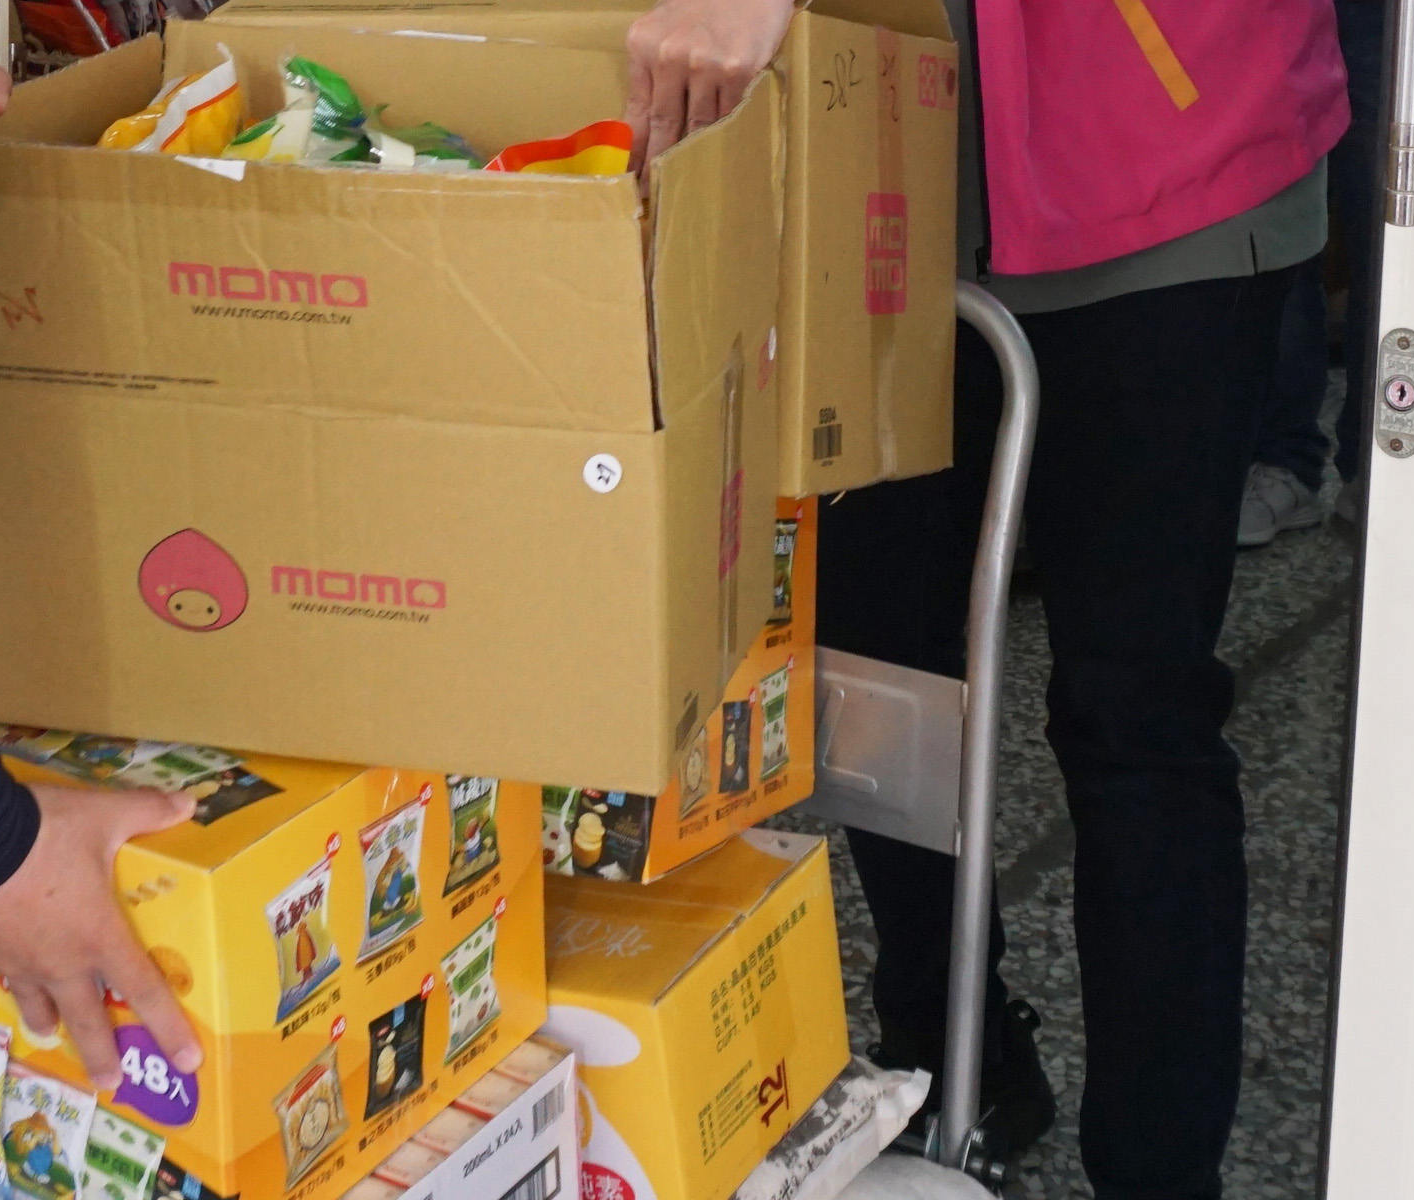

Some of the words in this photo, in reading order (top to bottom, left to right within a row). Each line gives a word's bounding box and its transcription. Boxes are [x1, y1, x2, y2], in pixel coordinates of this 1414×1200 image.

[167, 260, 369, 308] momo
[191, 302, 352, 327] www.momo.com.tw
[271, 565, 448, 609] momo
[288, 599, 432, 624] www.momo.com.tw
